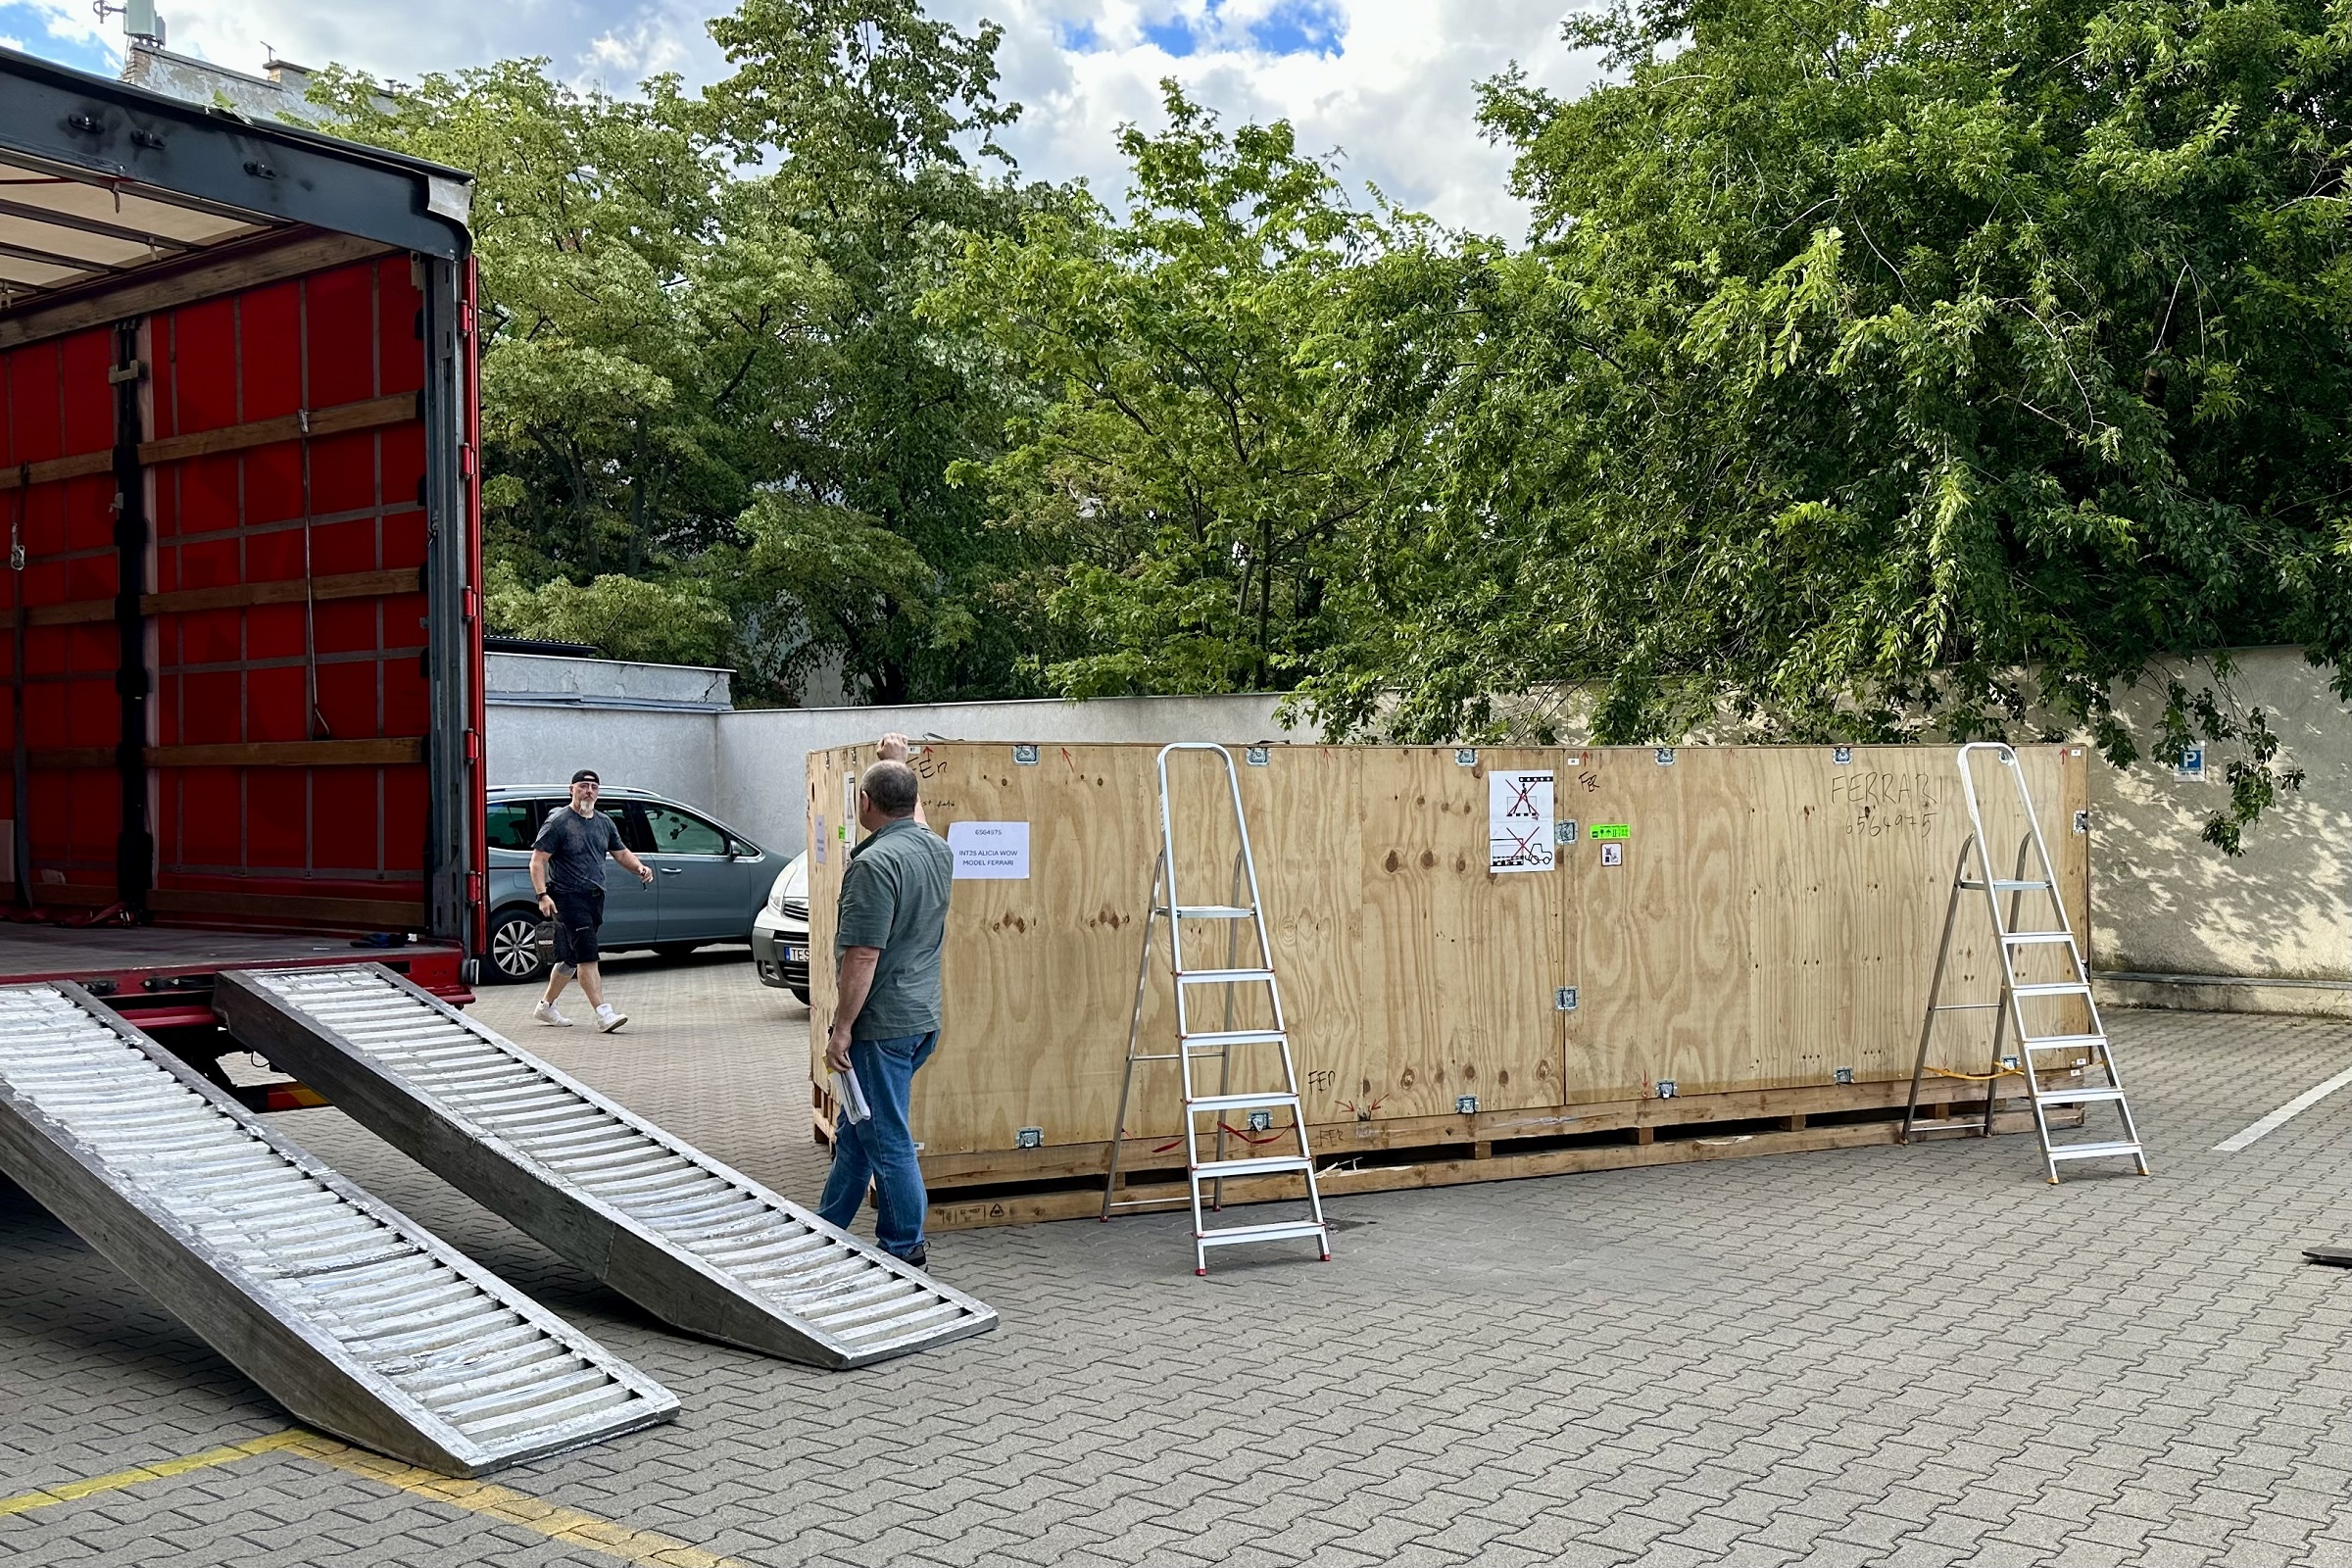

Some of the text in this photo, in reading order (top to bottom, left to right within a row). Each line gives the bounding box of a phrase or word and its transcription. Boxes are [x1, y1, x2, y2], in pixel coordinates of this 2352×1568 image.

[2183, 751, 2197, 767] P
[1832, 771, 1943, 806] FERRARI
[1845, 812, 1939, 838] 6564975
